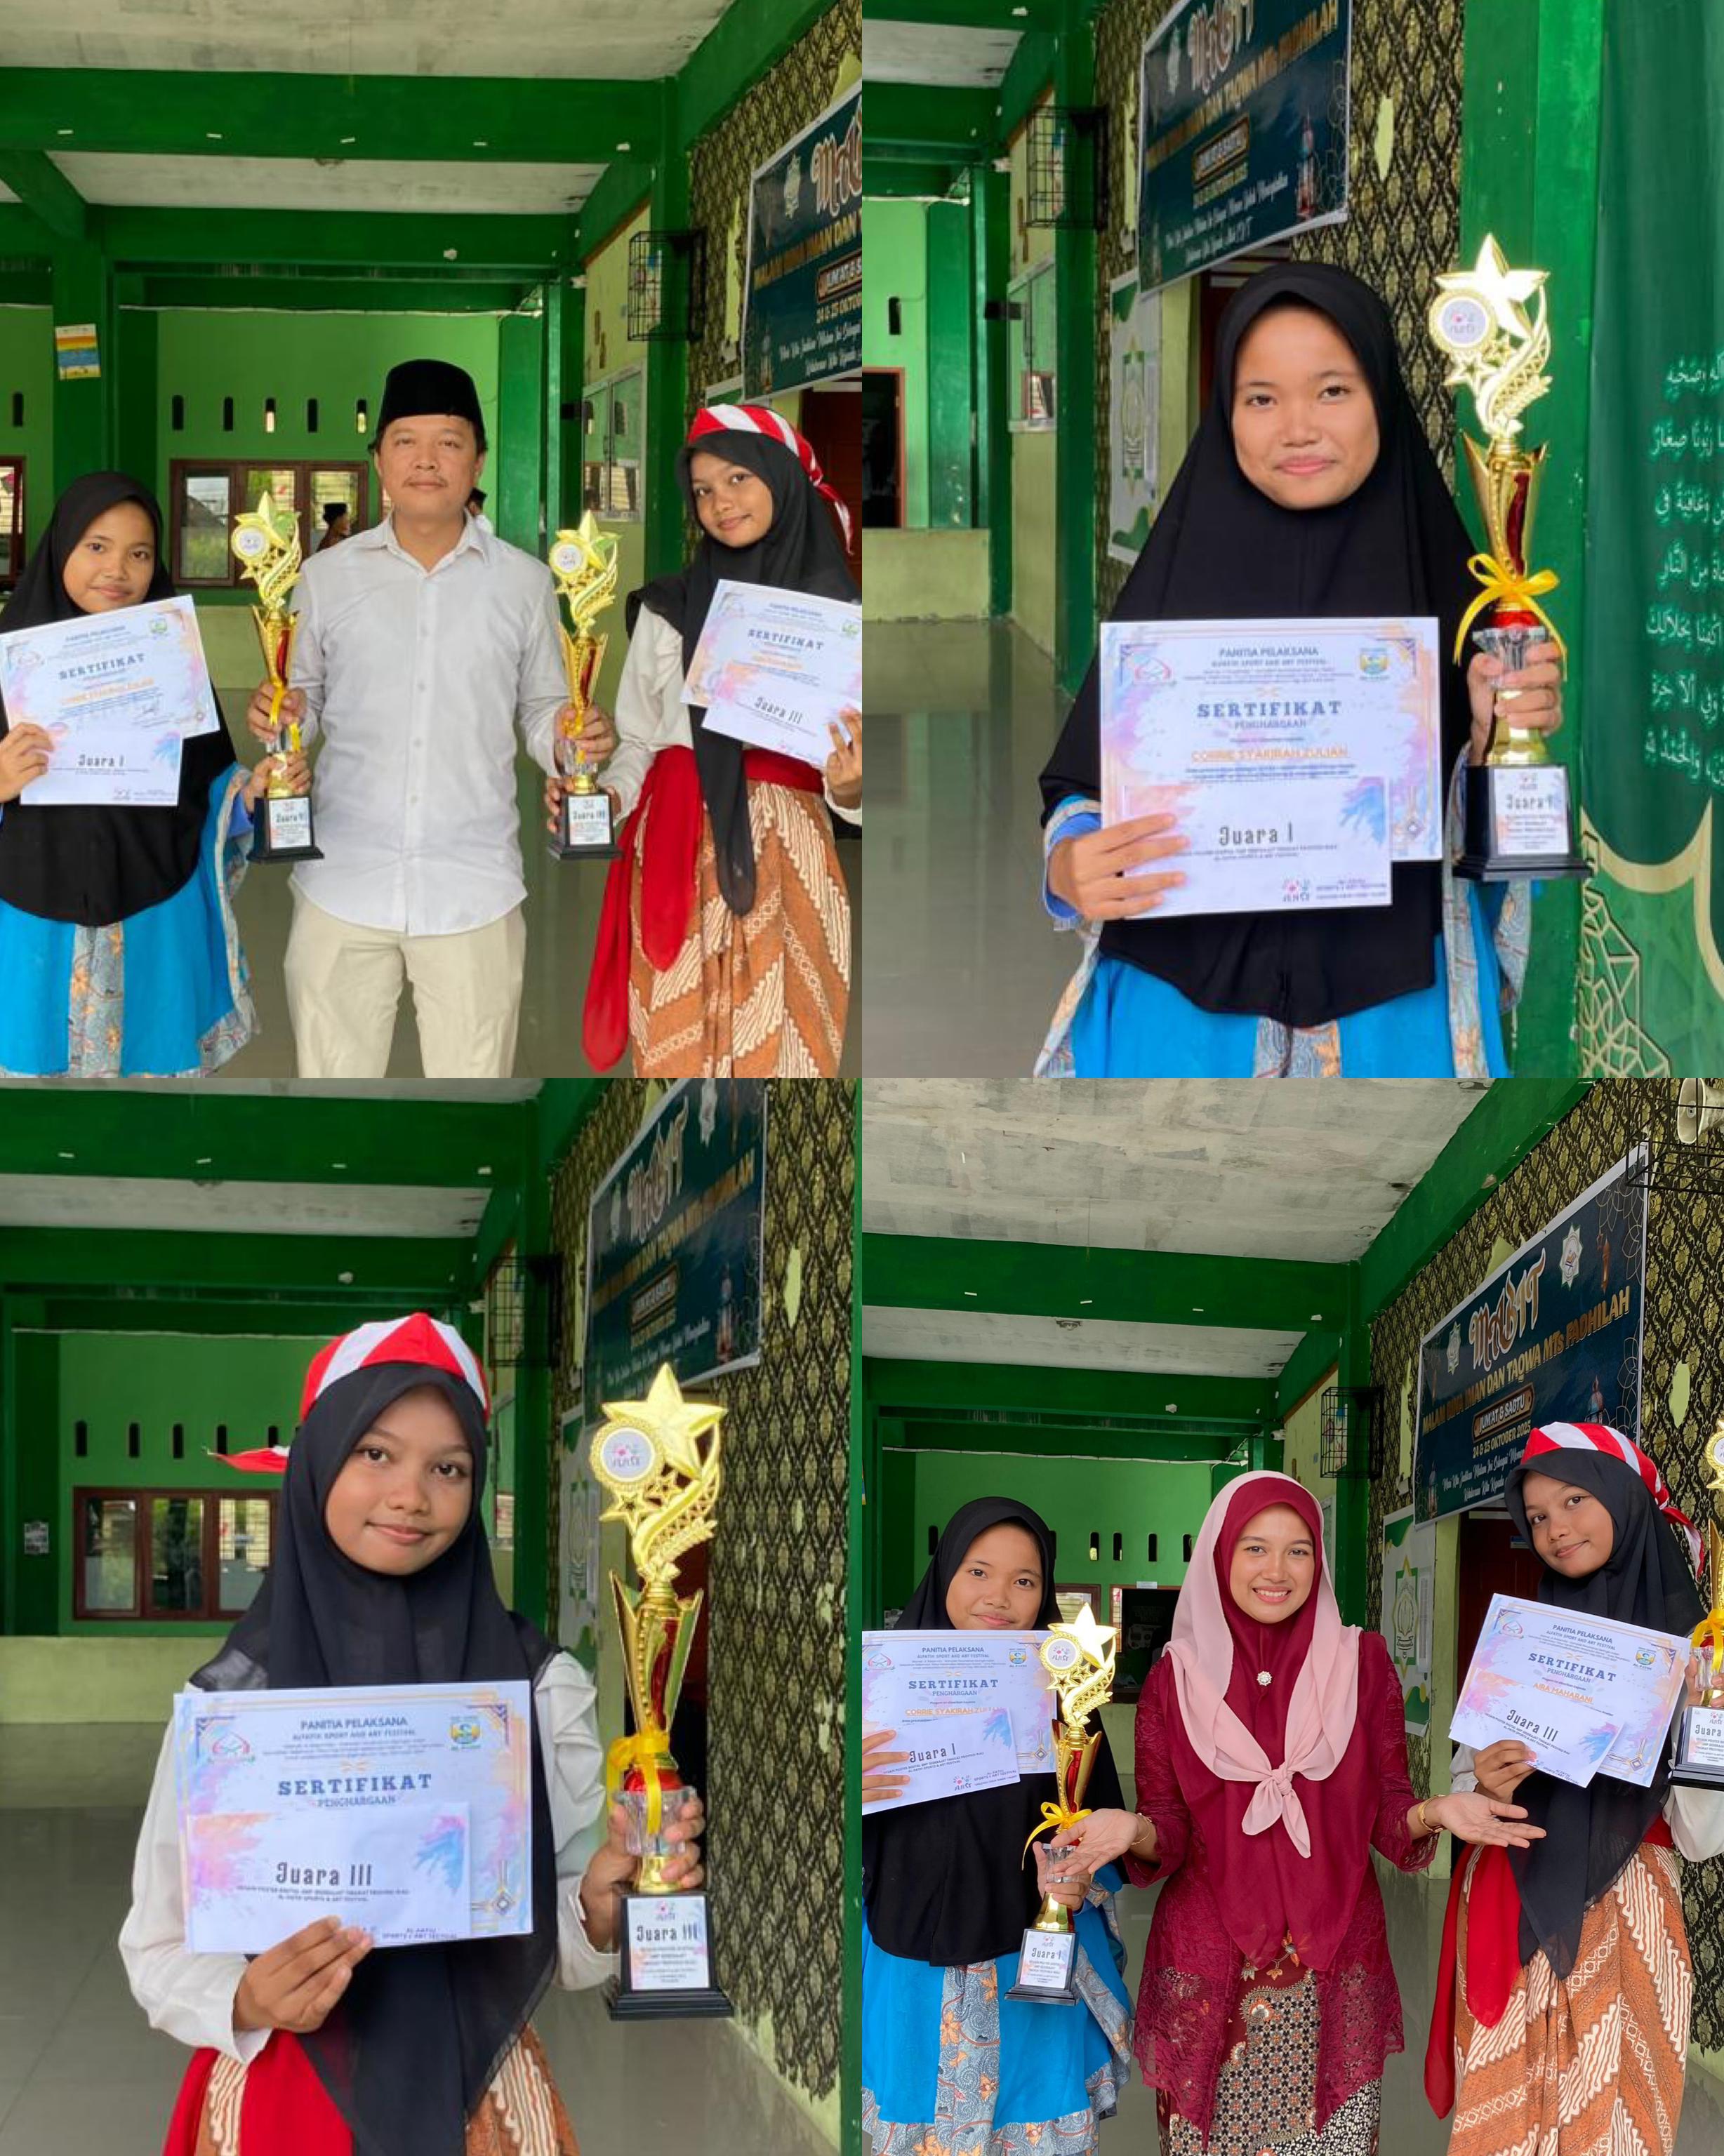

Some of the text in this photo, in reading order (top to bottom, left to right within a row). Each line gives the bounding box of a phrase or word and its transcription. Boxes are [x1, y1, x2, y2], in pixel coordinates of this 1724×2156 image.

[1197, 700, 1341, 718] SERTIFIKAT
[78, 754, 114, 767] Juara
[1219, 822, 1293, 845] Juara I
[1487, 1368, 1506, 1397] DAN
[1507, 1343, 1541, 1383] TAQWA
[1543, 1330, 1564, 1363] MTs
[1565, 1285, 1630, 1349] FADHILAH
[1504, 1393, 1525, 1418] SABTU
[1491, 1430, 1516, 1449] OKTOBER
[1517, 1420, 1531, 1438] 2025
[1553, 1625, 1612, 1644] PANITIA PELAKSANA
[1528, 1653, 1617, 1682] SERTIFIKAT
[1546, 1668, 1591, 1683] PENGHARGAAN
[908, 1679, 998, 1689] SERTIFIKAT
[1533, 1682, 1551, 1691] AIRA
[1552, 1687, 1593, 1703] MAHARANI
[345, 1717, 408, 1729] PELAKSANA
[1506, 1710, 1558, 1741] Juara III
[1695, 1724, 1721, 1737] Juara
[909, 1743, 956, 1763] Juara I
[278, 1774, 432, 1796] SERTIFIKAT
[317, 1795, 397, 1808] PENGHARGAAN
[276, 1861, 372, 1886] Juara III
[637, 1925, 677, 1942] Juara
[1031, 1948, 1056, 1959] Juara
